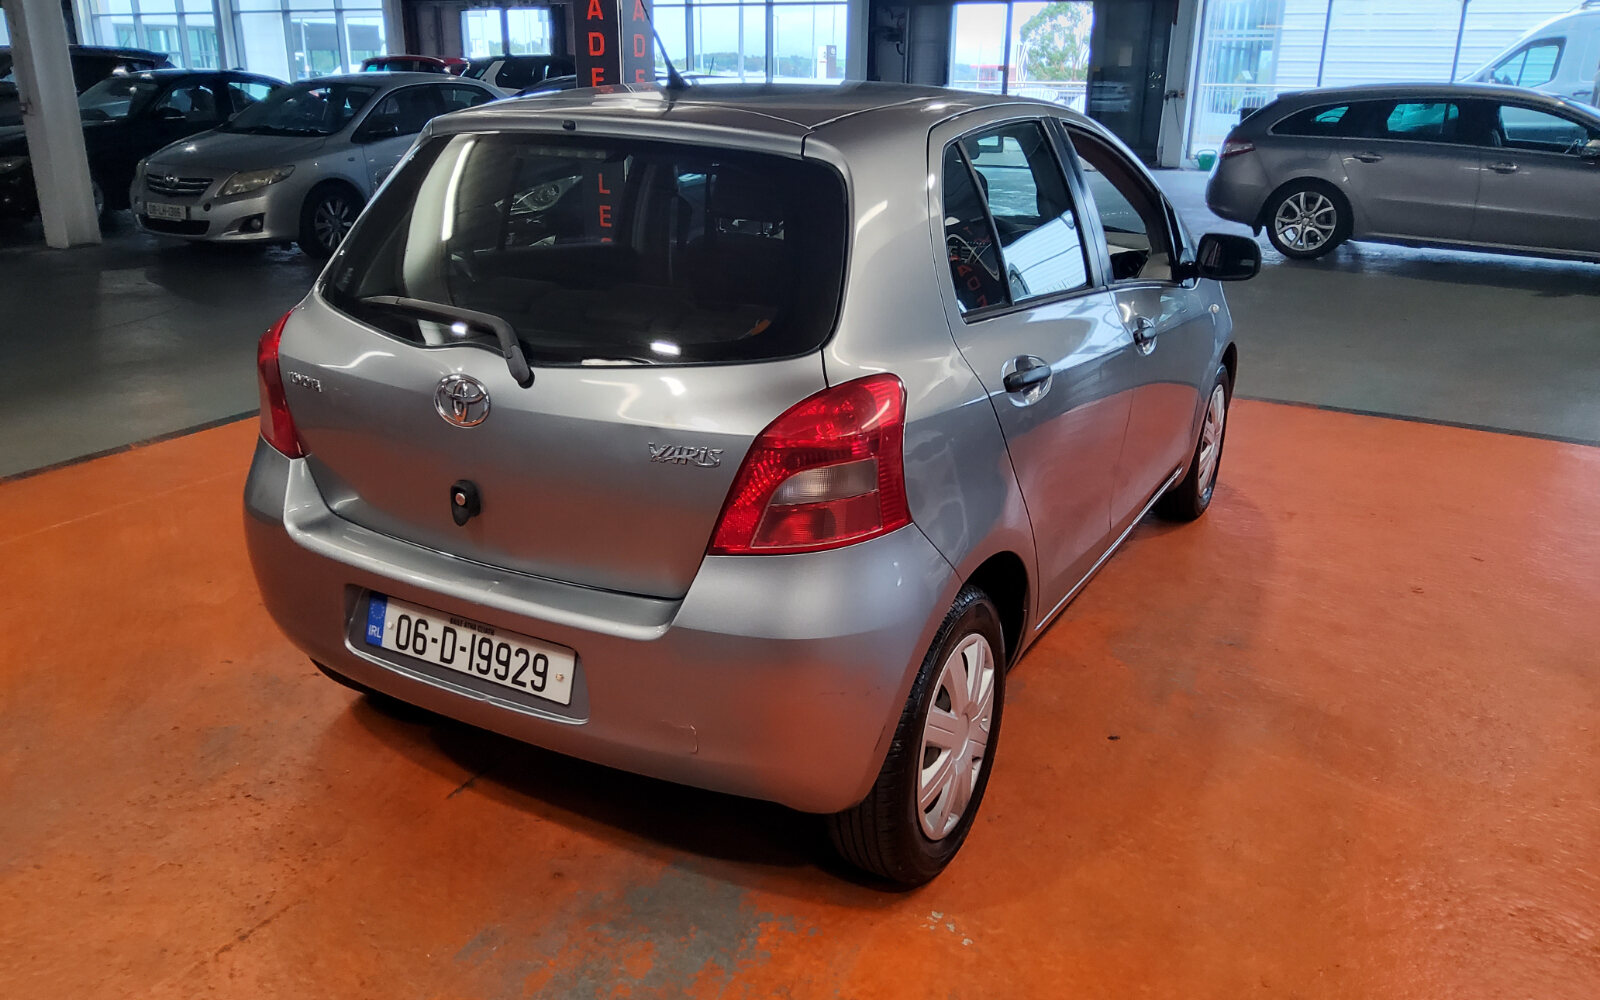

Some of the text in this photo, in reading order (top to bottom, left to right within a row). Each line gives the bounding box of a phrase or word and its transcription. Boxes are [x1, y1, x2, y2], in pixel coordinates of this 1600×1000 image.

[288, 371, 322, 393] TOYOTA
[648, 441, 724, 468] YARIS
[368, 624, 382, 639] IRL
[395, 614, 549, 692] 06-D-19929
